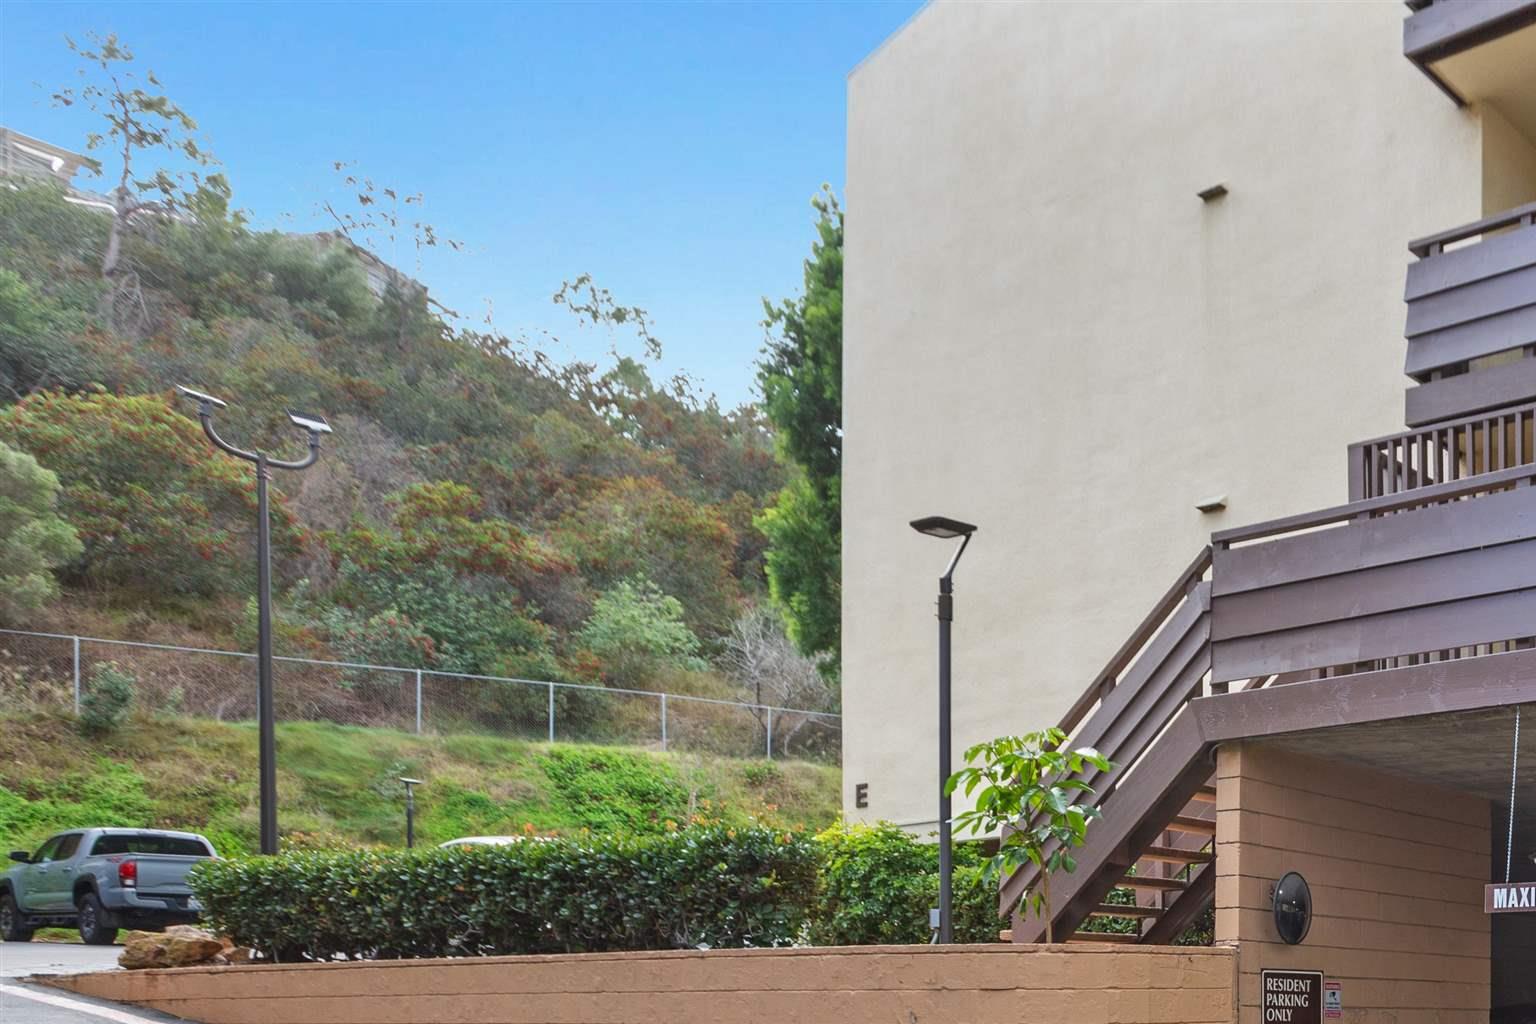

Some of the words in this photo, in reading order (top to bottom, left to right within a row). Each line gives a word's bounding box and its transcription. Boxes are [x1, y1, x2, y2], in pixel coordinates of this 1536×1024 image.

[856, 783, 868, 808] E
[1266, 977, 1312, 993] RESIDENT
[1266, 993, 1309, 1008] PARKING
[1266, 1008, 1293, 1022] ONLY
